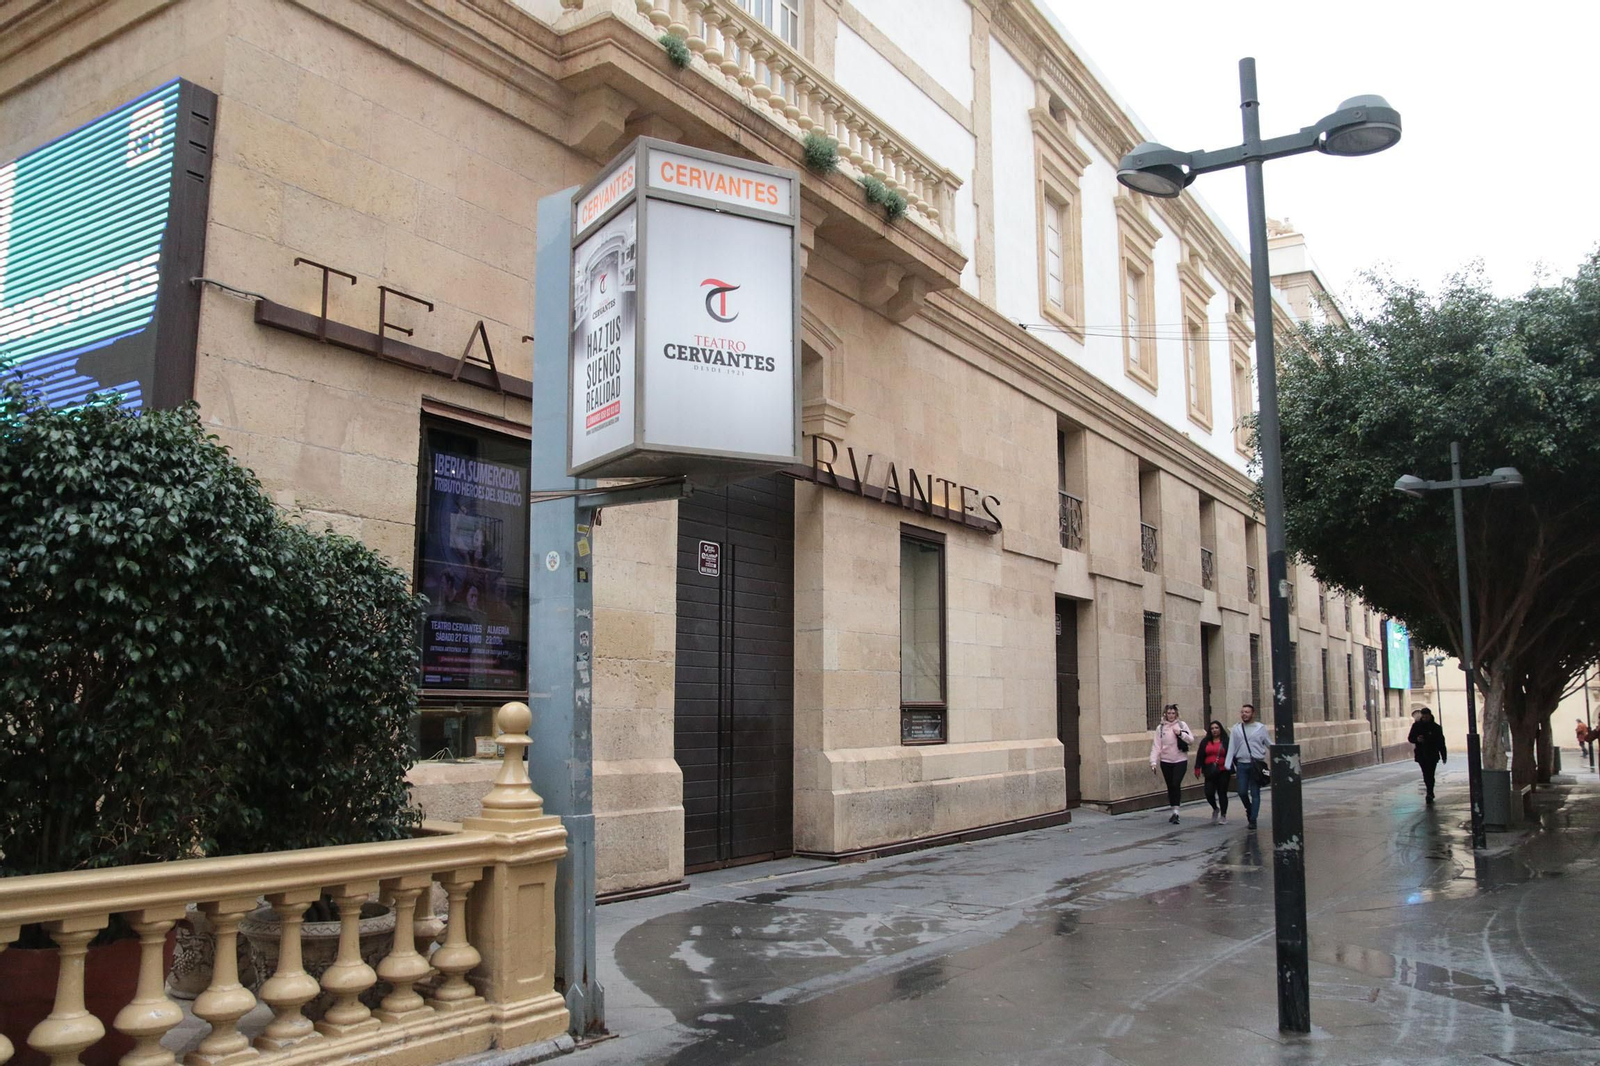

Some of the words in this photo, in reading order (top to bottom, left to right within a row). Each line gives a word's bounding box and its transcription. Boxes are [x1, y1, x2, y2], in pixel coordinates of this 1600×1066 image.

[582, 166, 634, 224] CERVANTES
[661, 161, 778, 205] CERVANTES
[587, 325, 603, 360] HAZ
[605, 315, 621, 349] TUS
[695, 335, 746, 353] TEATRO
[587, 346, 621, 390] SUEÑOS
[664, 343, 775, 372] CERVANTES
[294, 257, 533, 395] TEA
[802, 431, 1002, 534] RVANTES
[586, 375, 620, 413] REALIDAD
[435, 453, 466, 480] IBERIA
[468, 460, 520, 491] SUMERGIDA
[435, 477, 461, 494] TRIBUTO
[431, 620, 451, 631] TEATRO
[452, 622, 482, 634] CERVANTES
